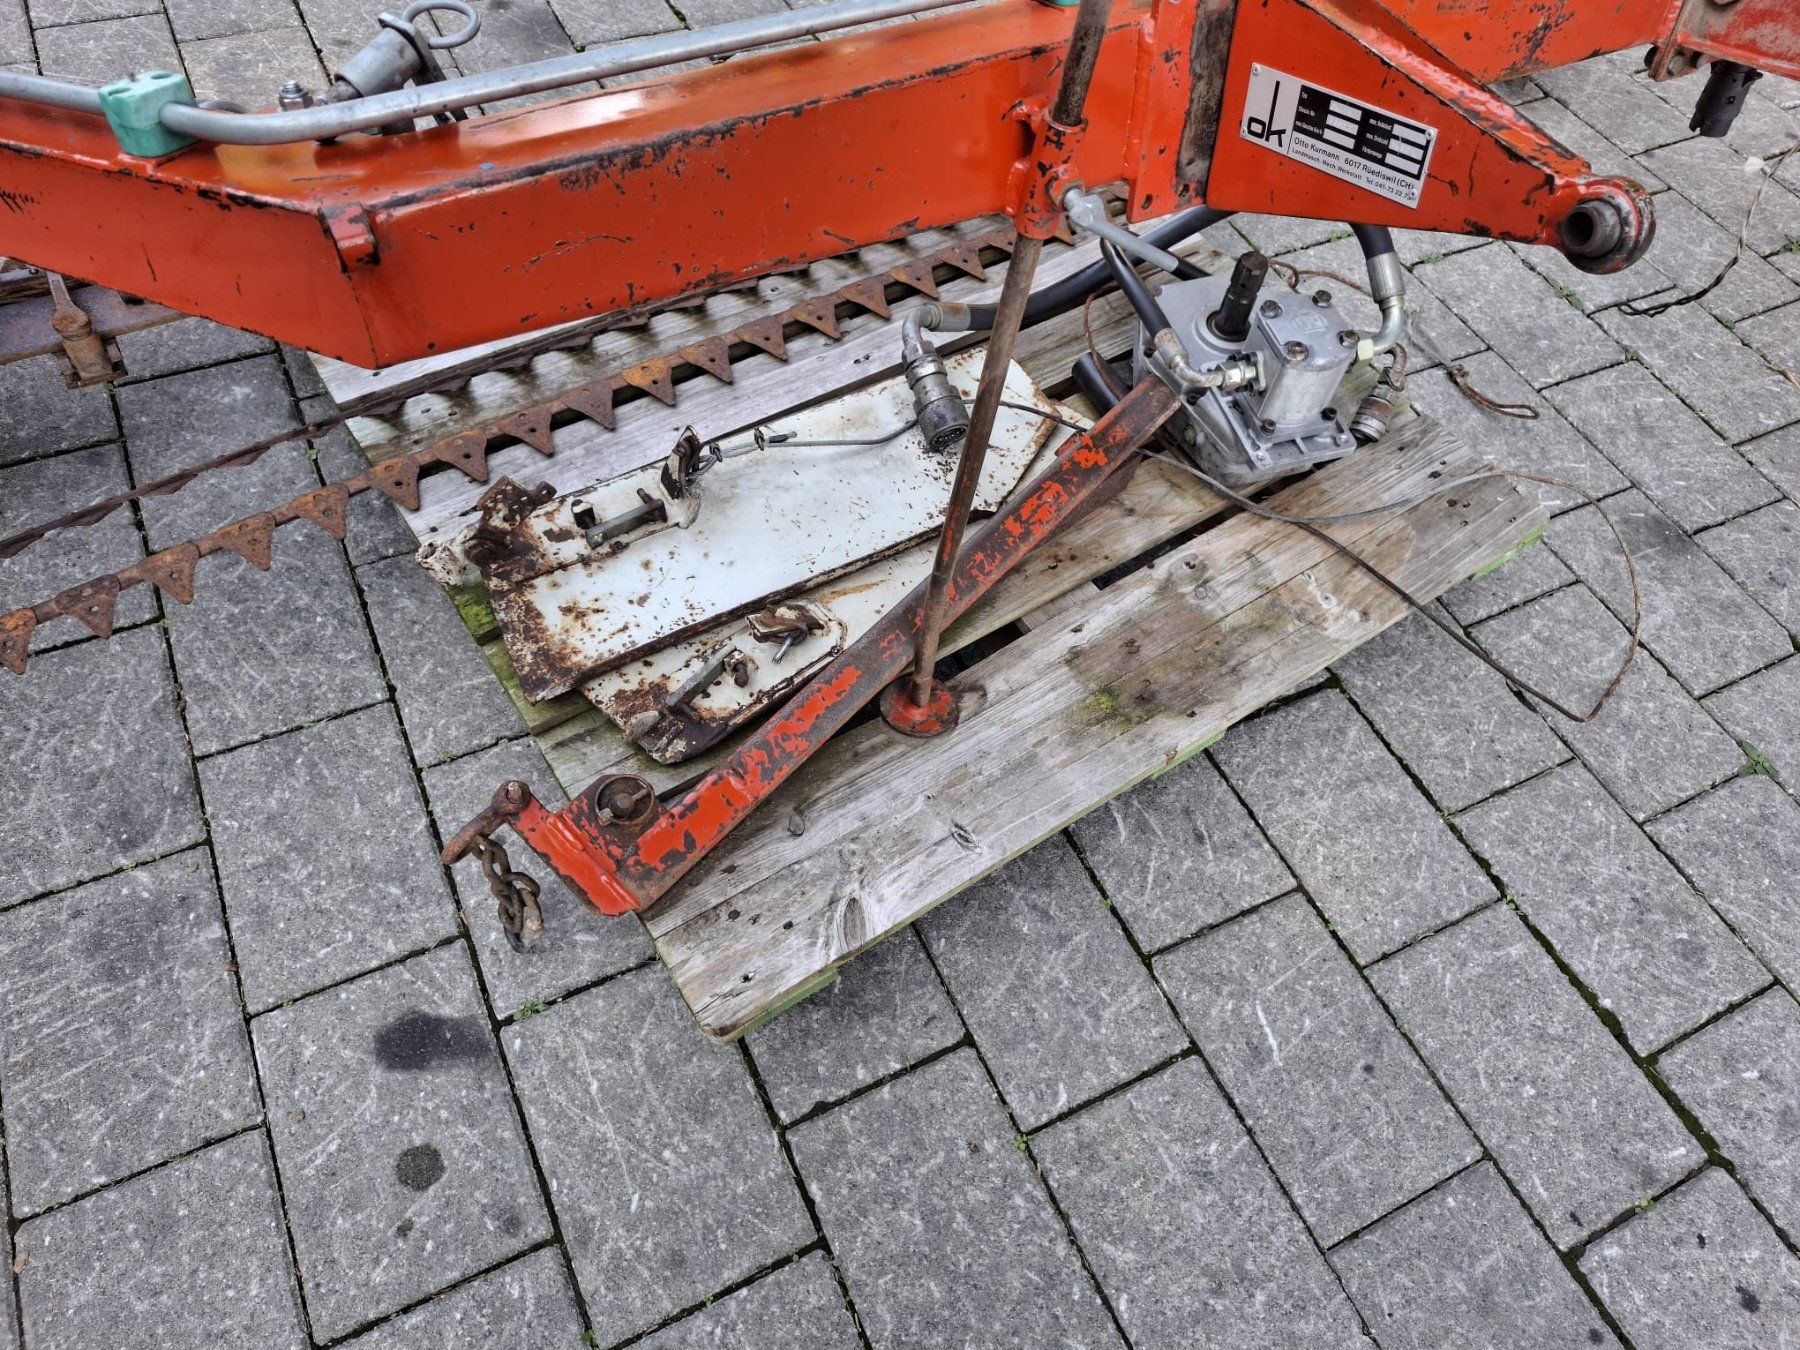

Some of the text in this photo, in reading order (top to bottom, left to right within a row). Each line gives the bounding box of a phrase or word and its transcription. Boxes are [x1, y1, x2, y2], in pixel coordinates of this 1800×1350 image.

[1294, 136, 1309, 148] Otto
[1310, 143, 1340, 160] Kurmann
[1343, 156, 1361, 170] 6017
